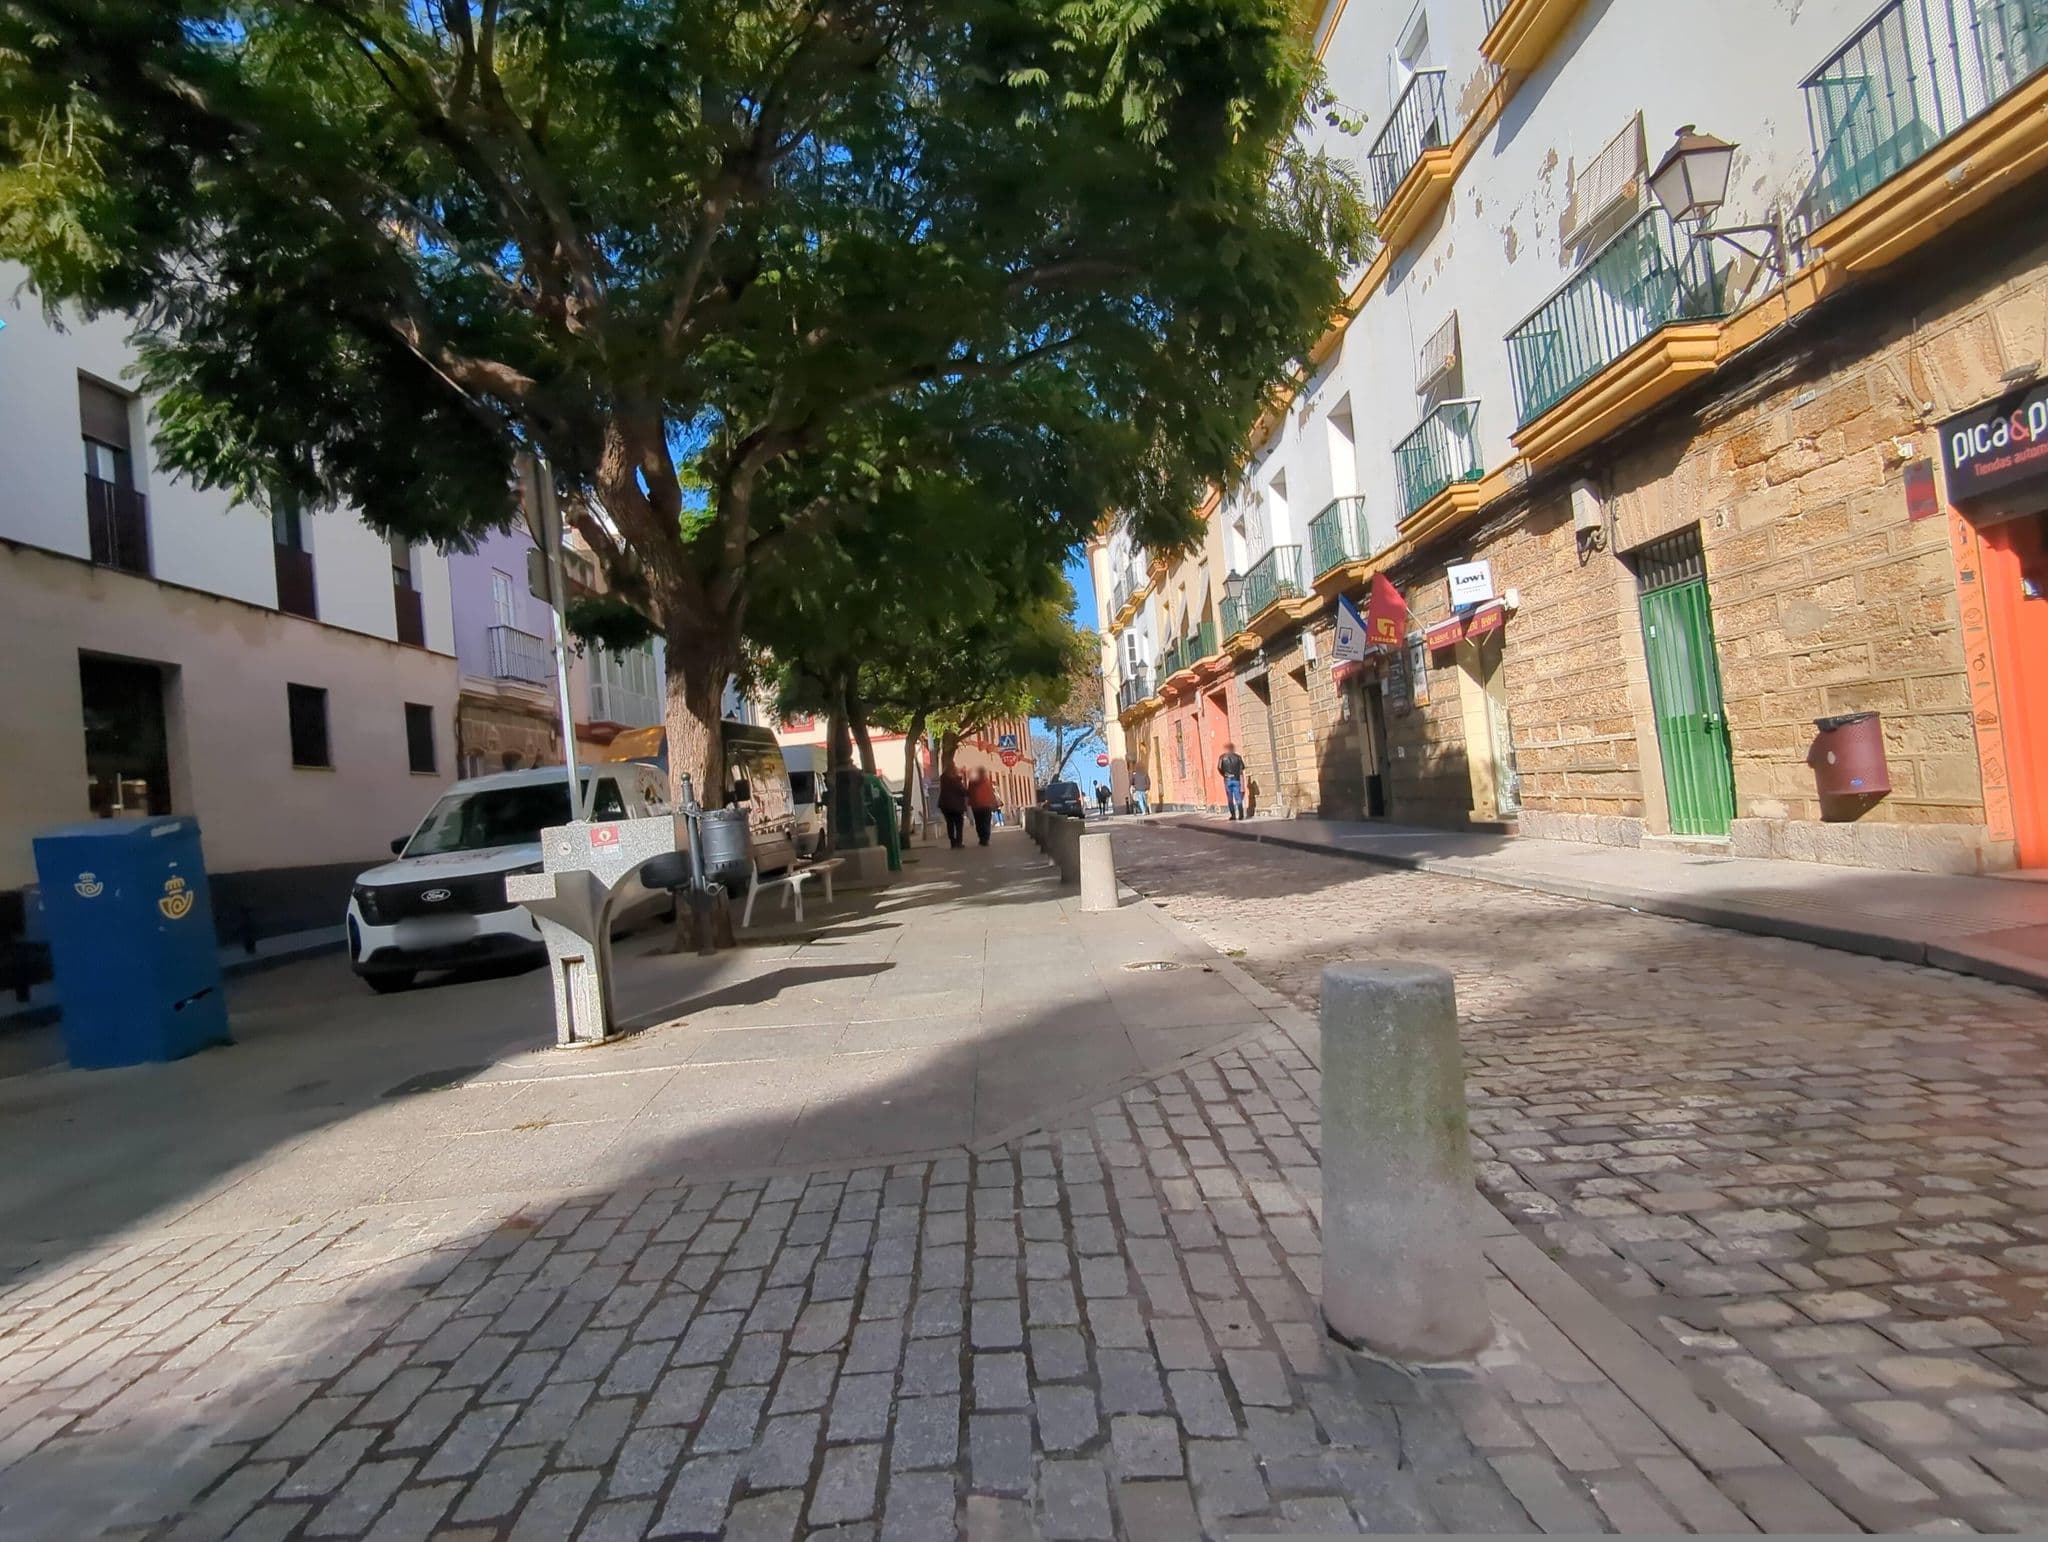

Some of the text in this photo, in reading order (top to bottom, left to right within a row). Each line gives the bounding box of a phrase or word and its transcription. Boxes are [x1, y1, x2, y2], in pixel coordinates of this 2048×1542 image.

[1952, 398, 2048, 469] pica&p
[1974, 455, 2012, 476] Tiendas
[1455, 571, 1485, 585] Lowi
[1003, 755, 1017, 763] STOP
